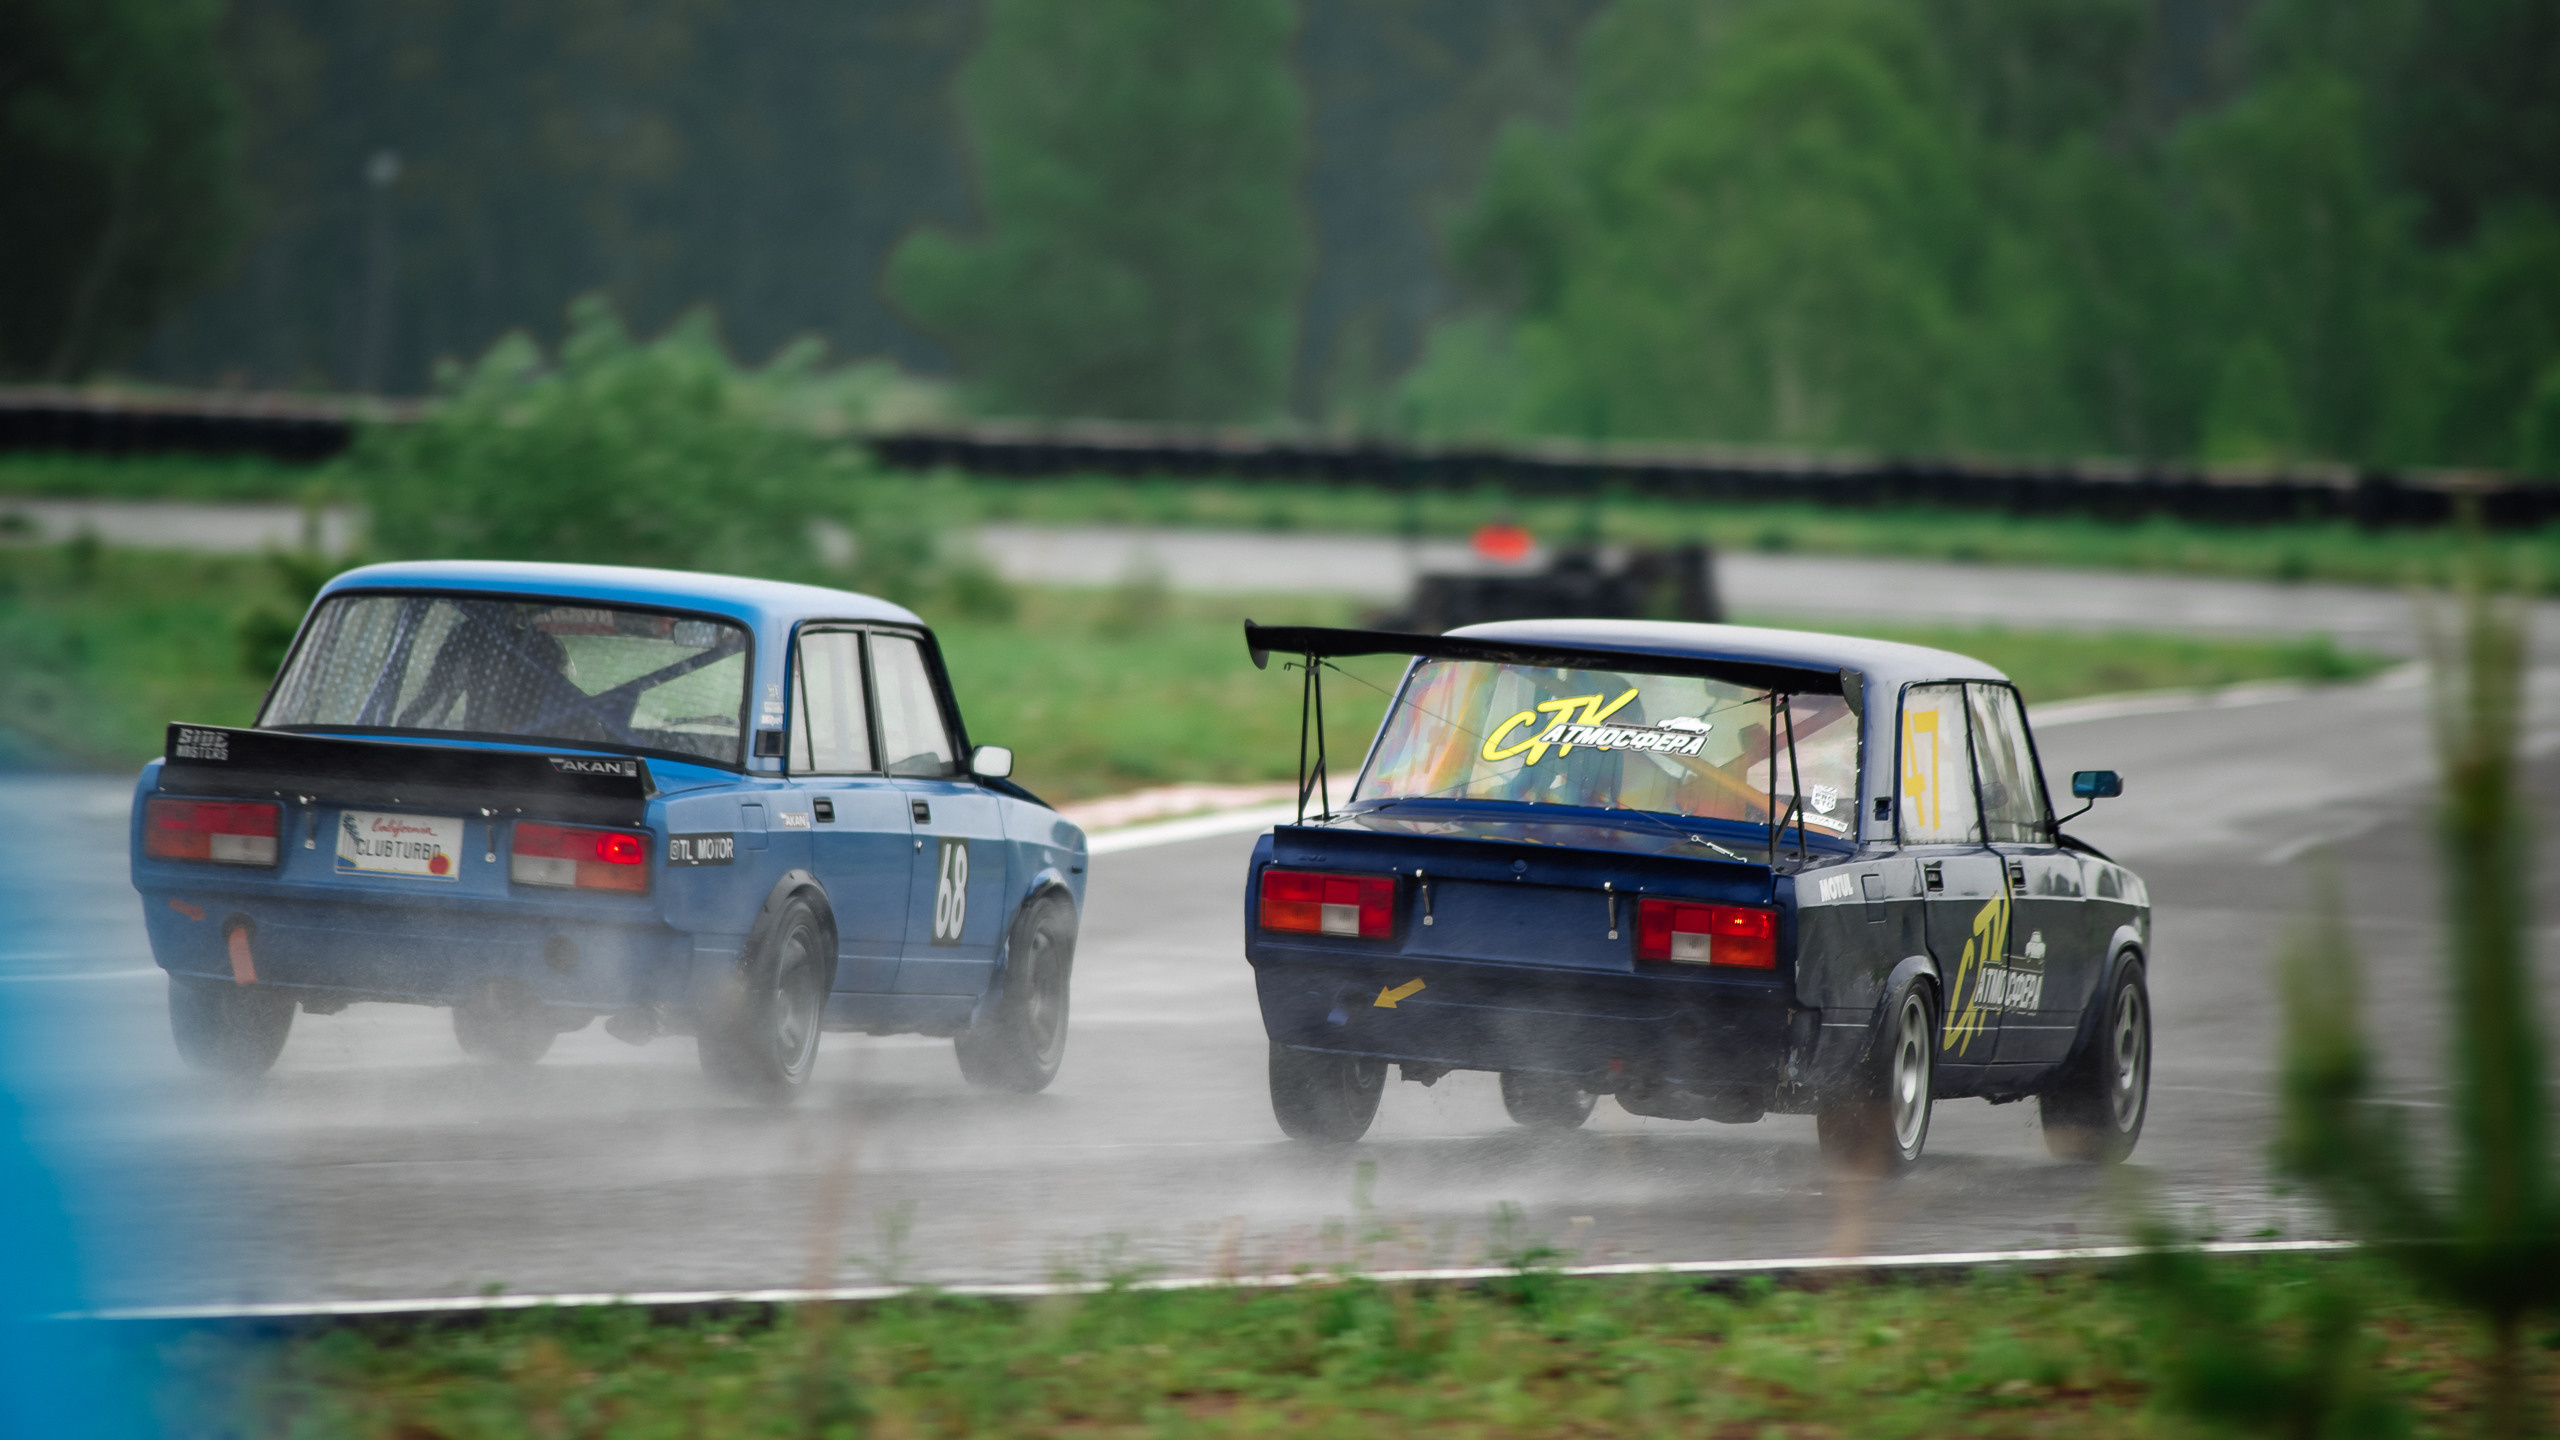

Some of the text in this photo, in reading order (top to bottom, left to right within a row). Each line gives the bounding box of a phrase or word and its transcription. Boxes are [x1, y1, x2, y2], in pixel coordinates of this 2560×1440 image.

[1539, 723, 1708, 757] АТМОСФЕРА
[563, 761, 621, 774] AKAN
[1902, 708, 1940, 831] 47
[371, 817, 438, 837] California
[936, 843, 968, 939] 68
[1819, 873, 1853, 902] MOTUL
[1974, 967, 2043, 1011] АТМОСФЕРА
